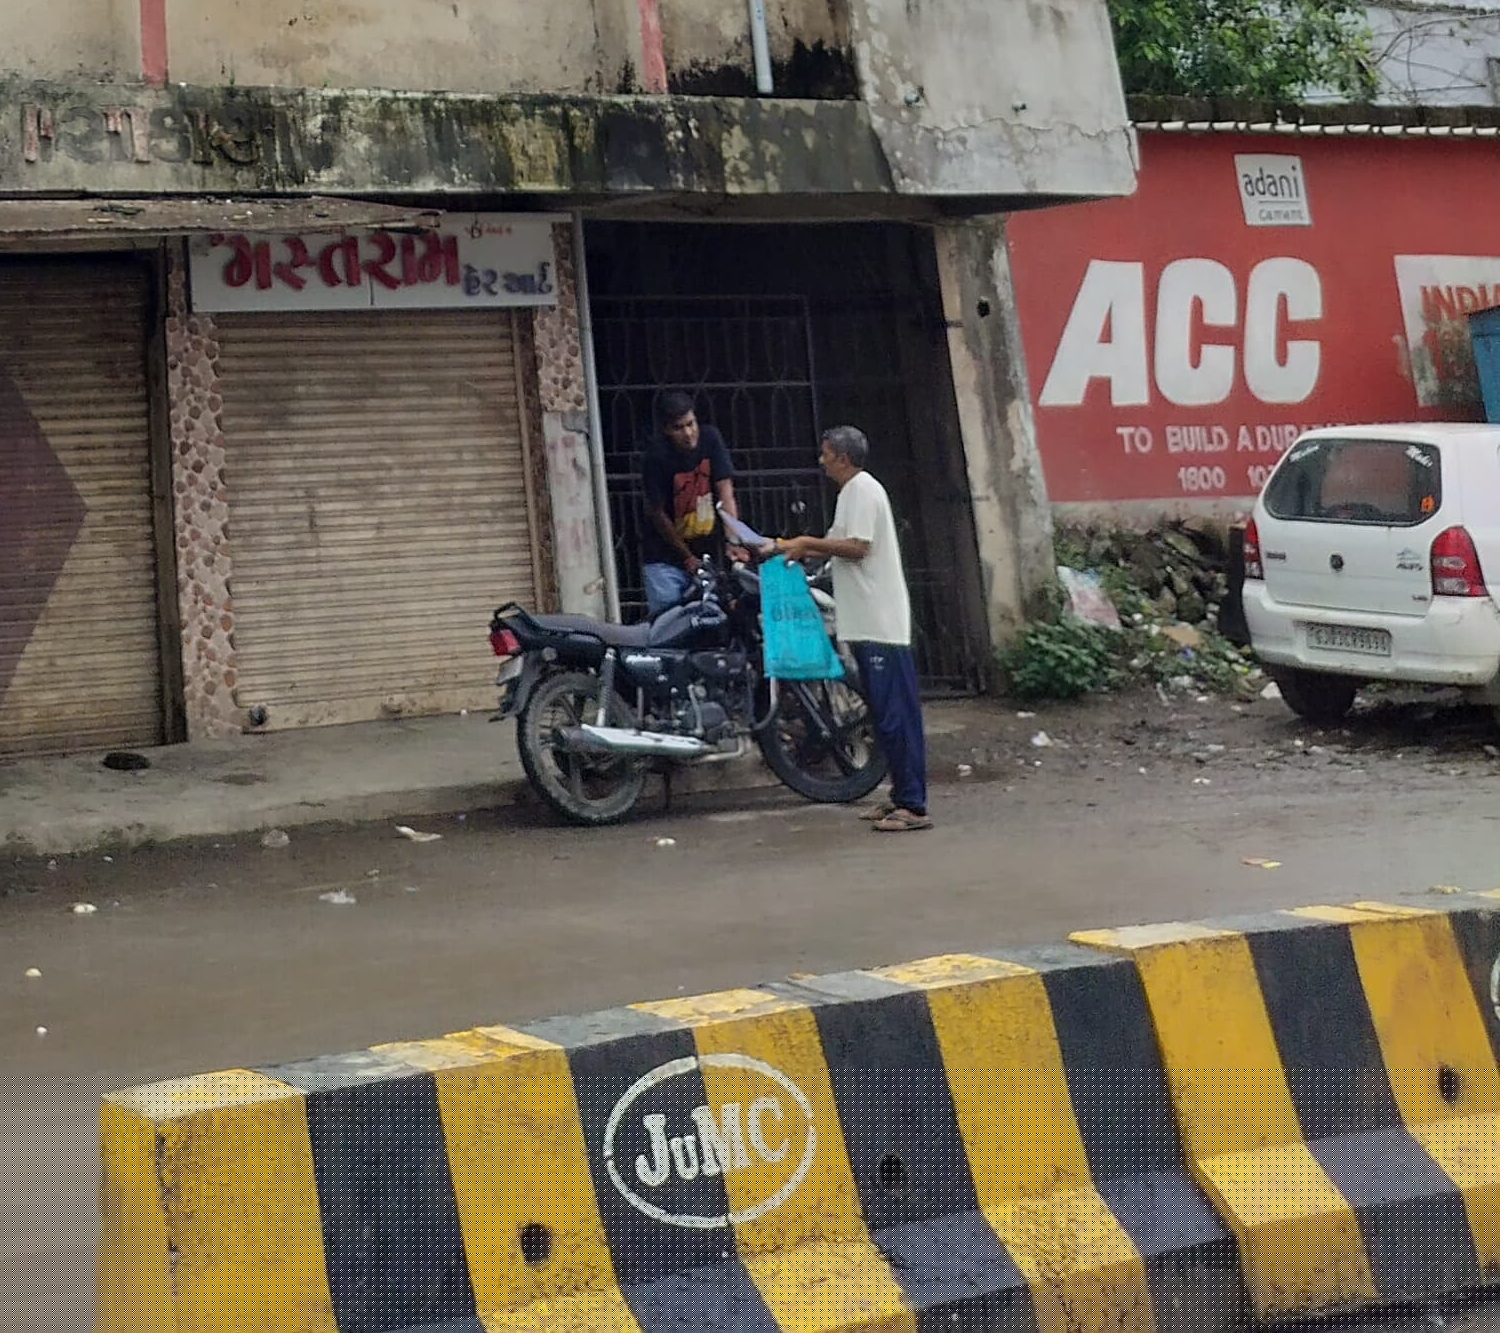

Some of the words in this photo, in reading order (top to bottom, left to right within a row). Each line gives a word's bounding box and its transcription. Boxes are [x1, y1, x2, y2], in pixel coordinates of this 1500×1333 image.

[1242, 165, 1300, 198] adani
[1419, 283, 1500, 324] INDI
[1038, 257, 1323, 407] ACC
[1115, 425, 1152, 454] TO
[1165, 424, 1229, 454] BUILD
[1177, 465, 1226, 491] 1800
[1247, 464, 1277, 489] 10
[634, 1096, 790, 1187] JuMC
